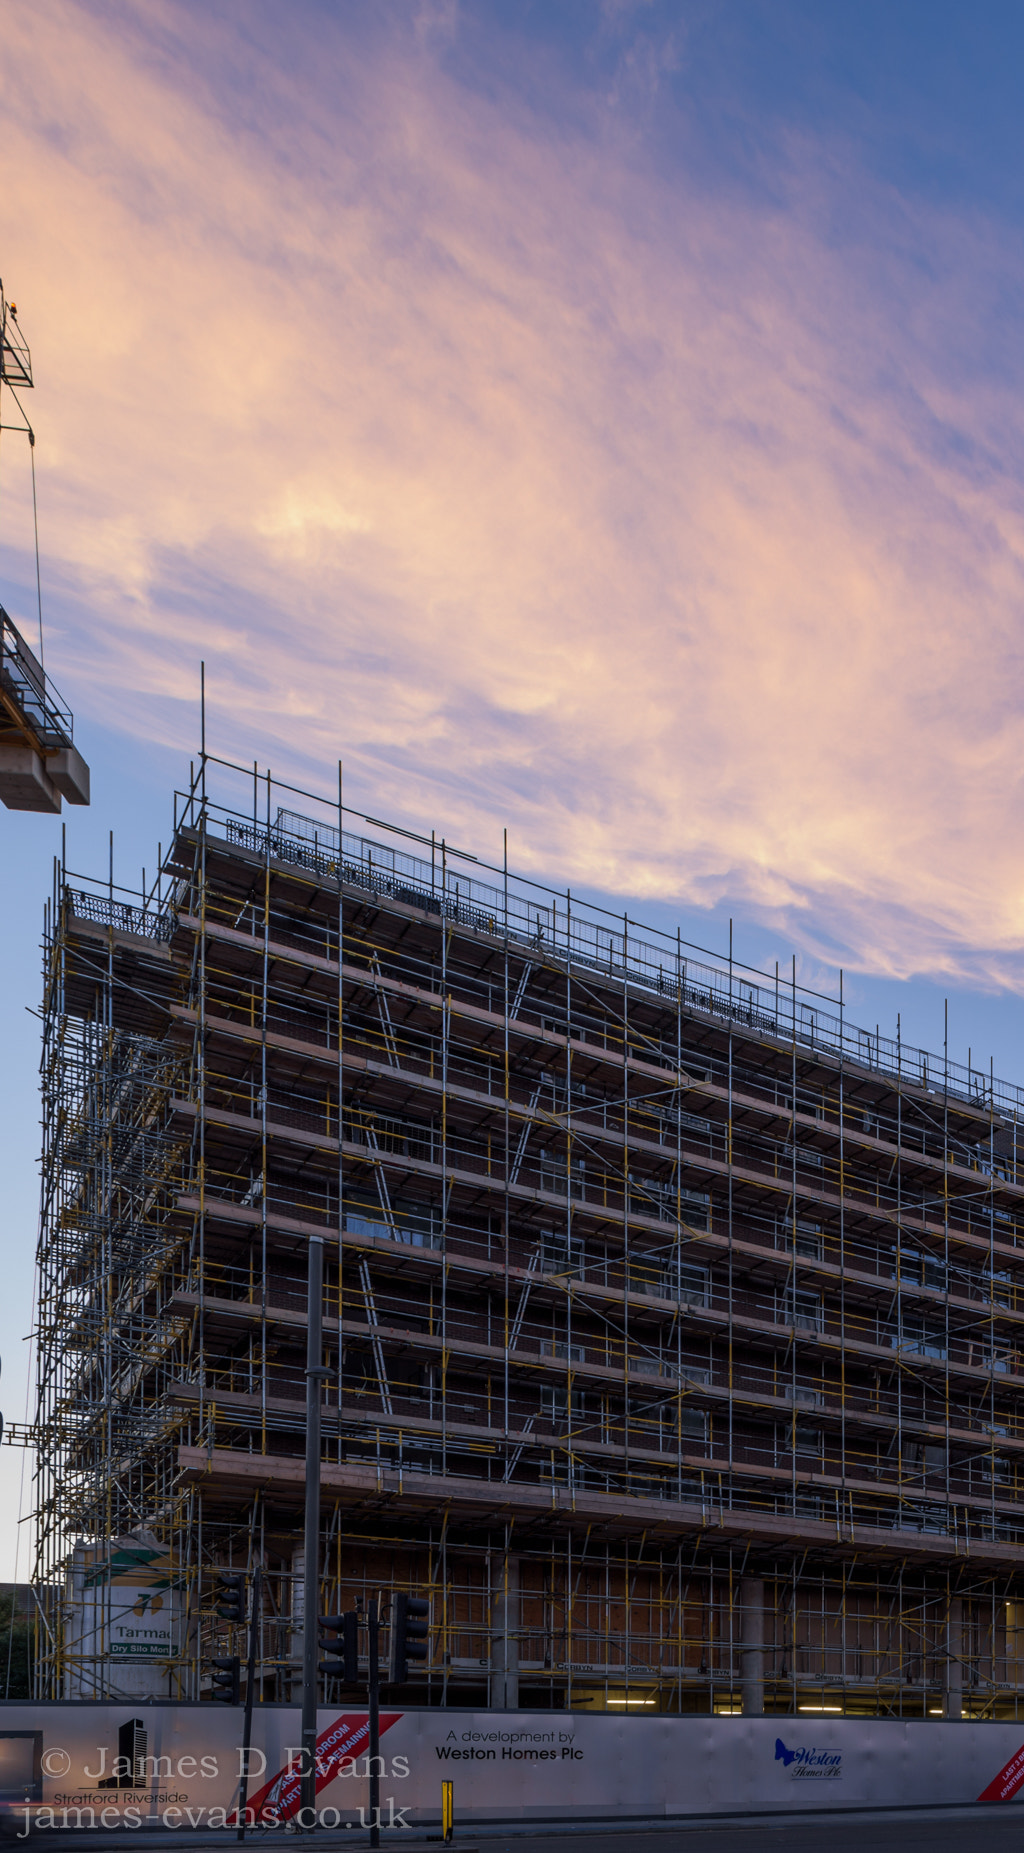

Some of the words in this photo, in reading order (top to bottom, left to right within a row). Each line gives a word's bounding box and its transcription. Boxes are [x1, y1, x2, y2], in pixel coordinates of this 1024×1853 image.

[112, 1645, 128, 1654] Dry
[131, 1645, 148, 1653] Silo
[446, 1730, 457, 1742] A
[461, 1730, 556, 1744] development
[559, 1731, 575, 1744] by
[435, 1747, 496, 1760] Weston
[502, 1747, 557, 1760] Homes
[562, 1747, 584, 1760] Plc
[795, 1747, 842, 1766] Weston
[1002, 1764, 1017, 1781] LAST
[54, 1792, 119, 1806] Stratford
[123, 1791, 189, 1804] Riverside
